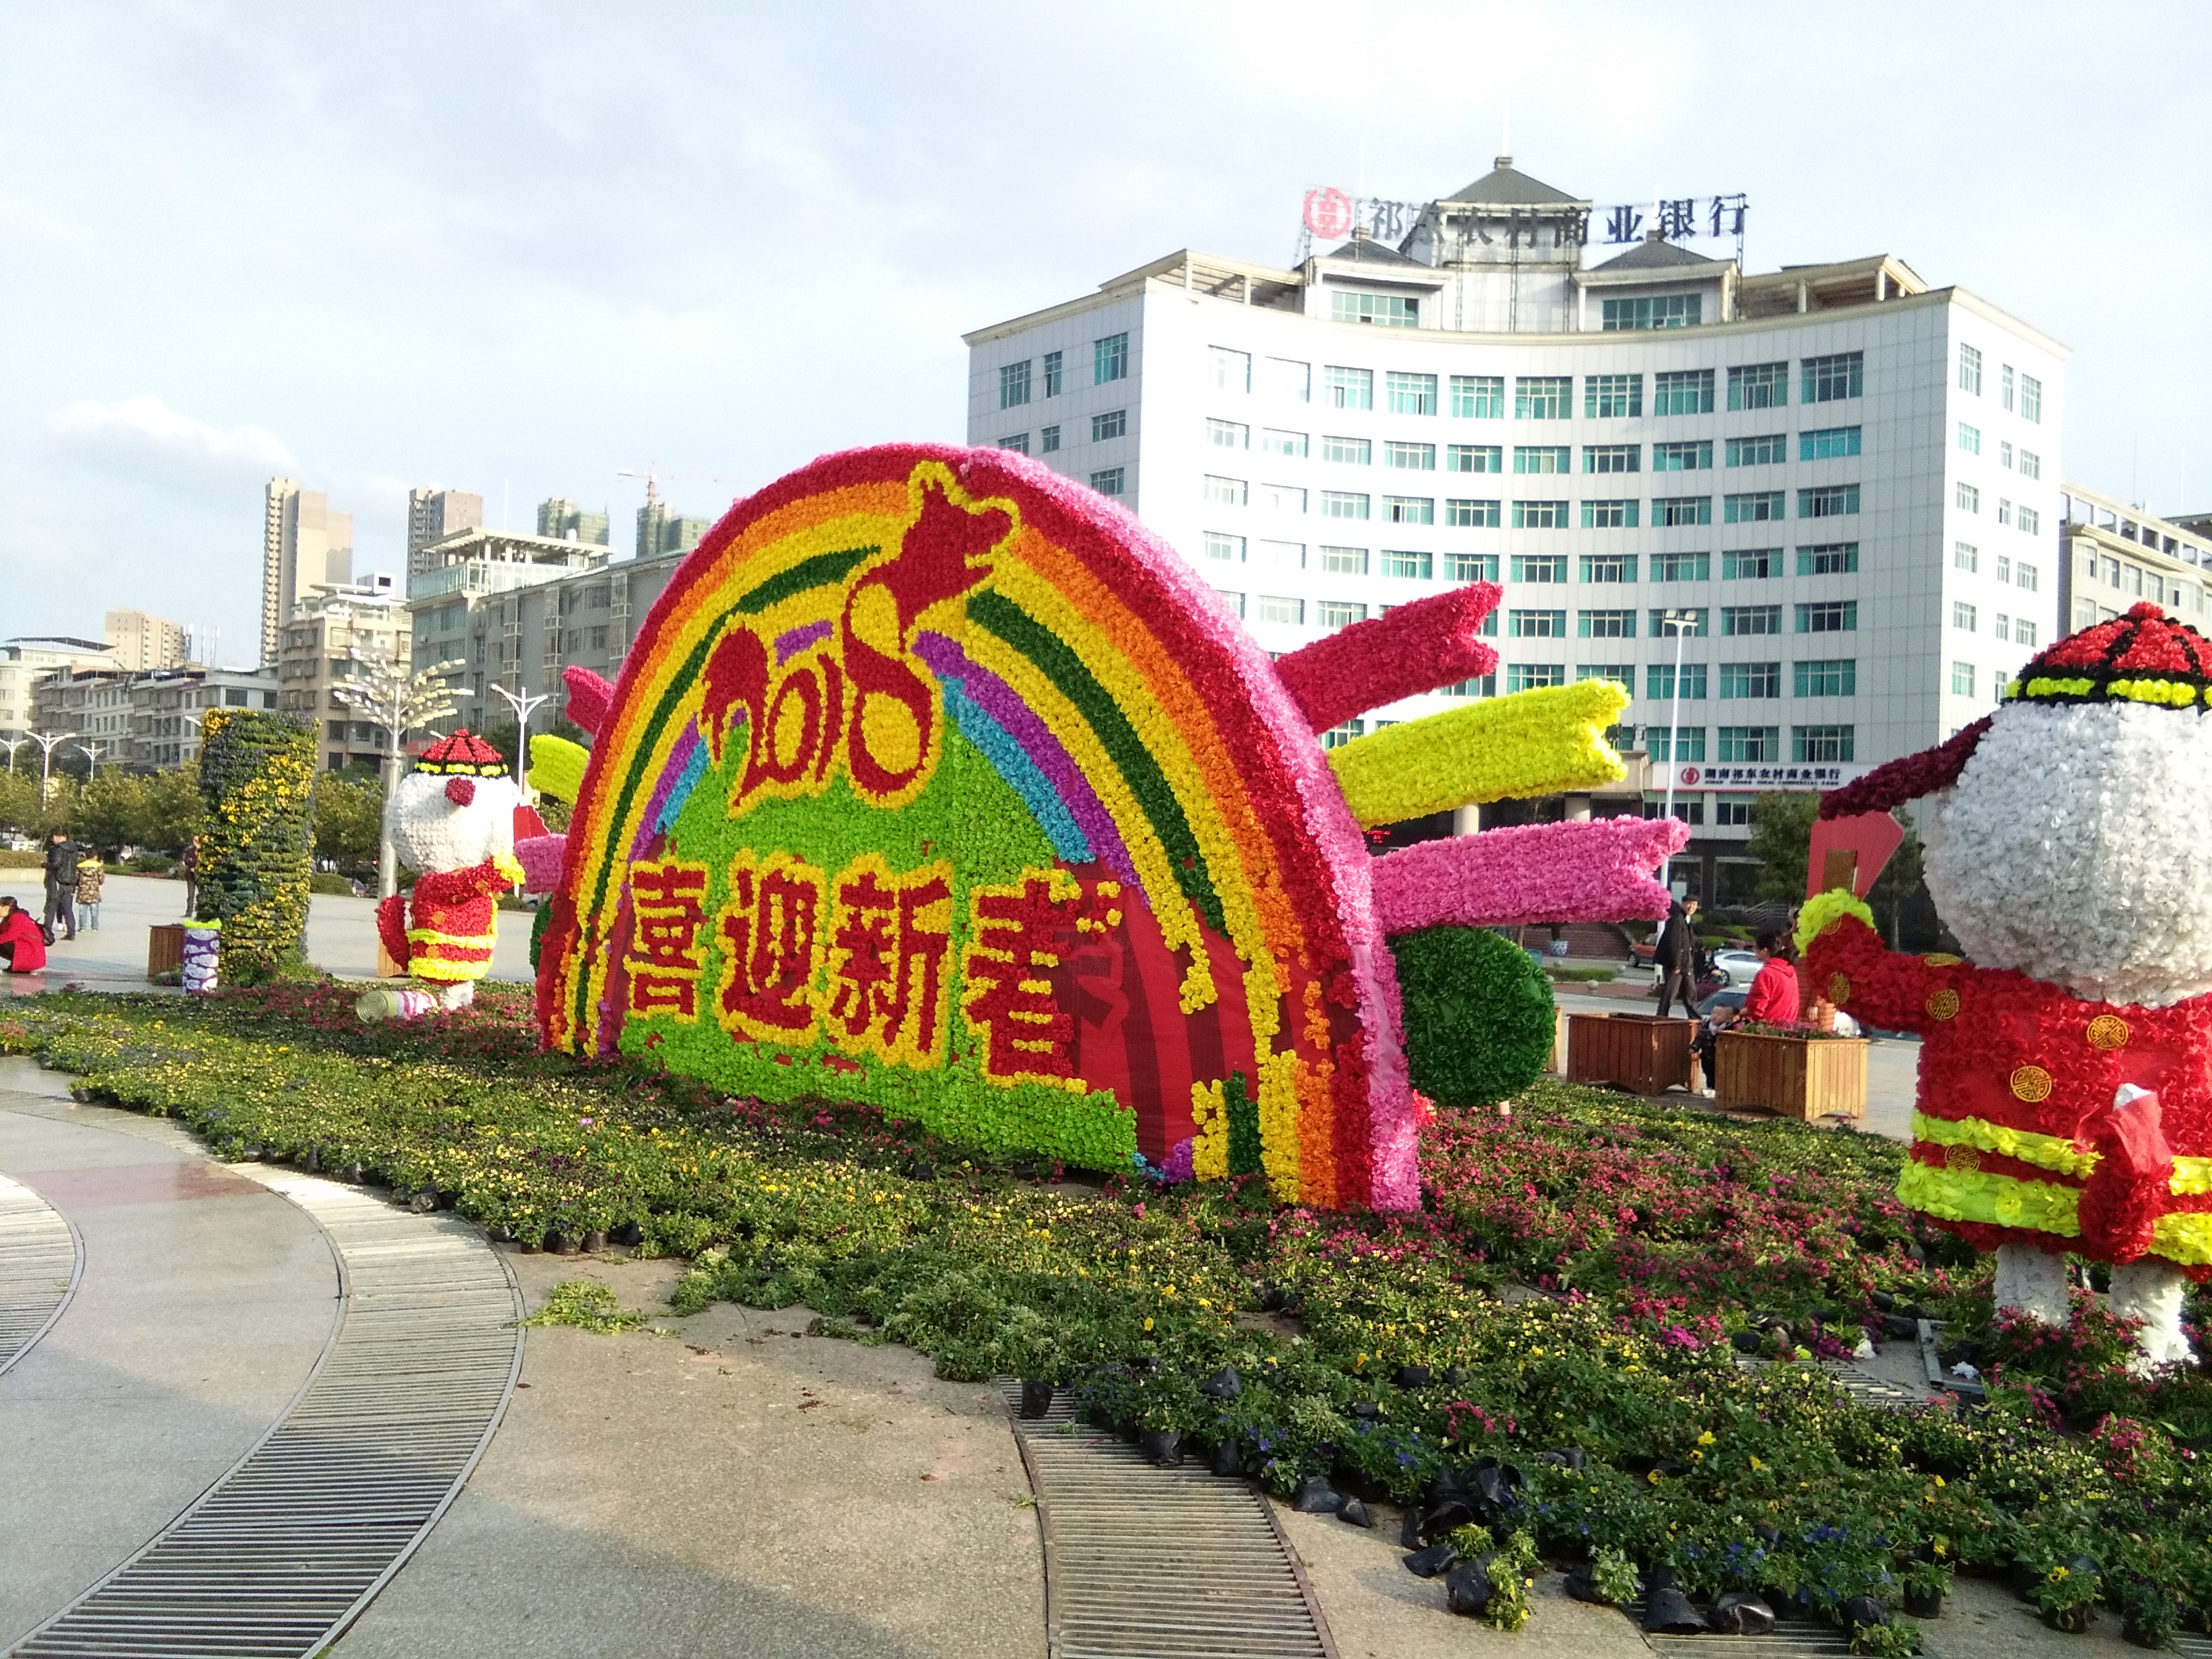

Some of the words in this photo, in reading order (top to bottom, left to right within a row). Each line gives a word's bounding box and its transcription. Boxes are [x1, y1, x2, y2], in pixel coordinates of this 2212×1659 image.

[700, 476, 1014, 809] 2018
[626, 851, 1115, 1091] 喜迎新春
